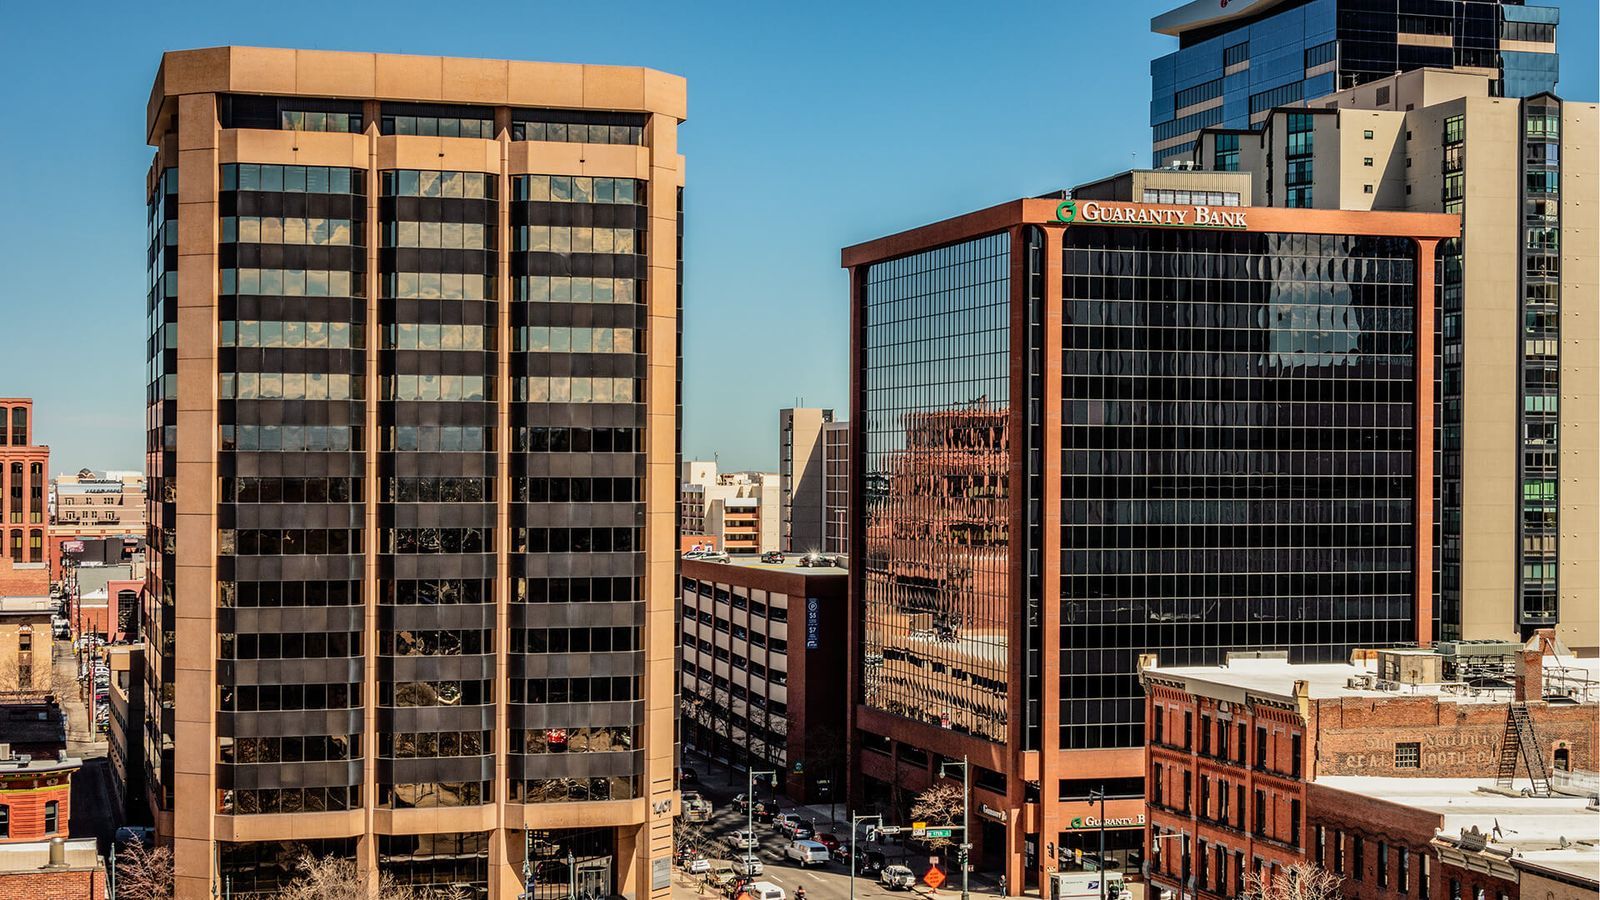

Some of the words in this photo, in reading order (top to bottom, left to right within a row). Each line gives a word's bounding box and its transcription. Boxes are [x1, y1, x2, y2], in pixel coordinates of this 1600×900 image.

[1082, 202, 1188, 225] GUARANTY
[1194, 206, 1248, 227] BANK
[1085, 816, 1133, 827] GURANTY
